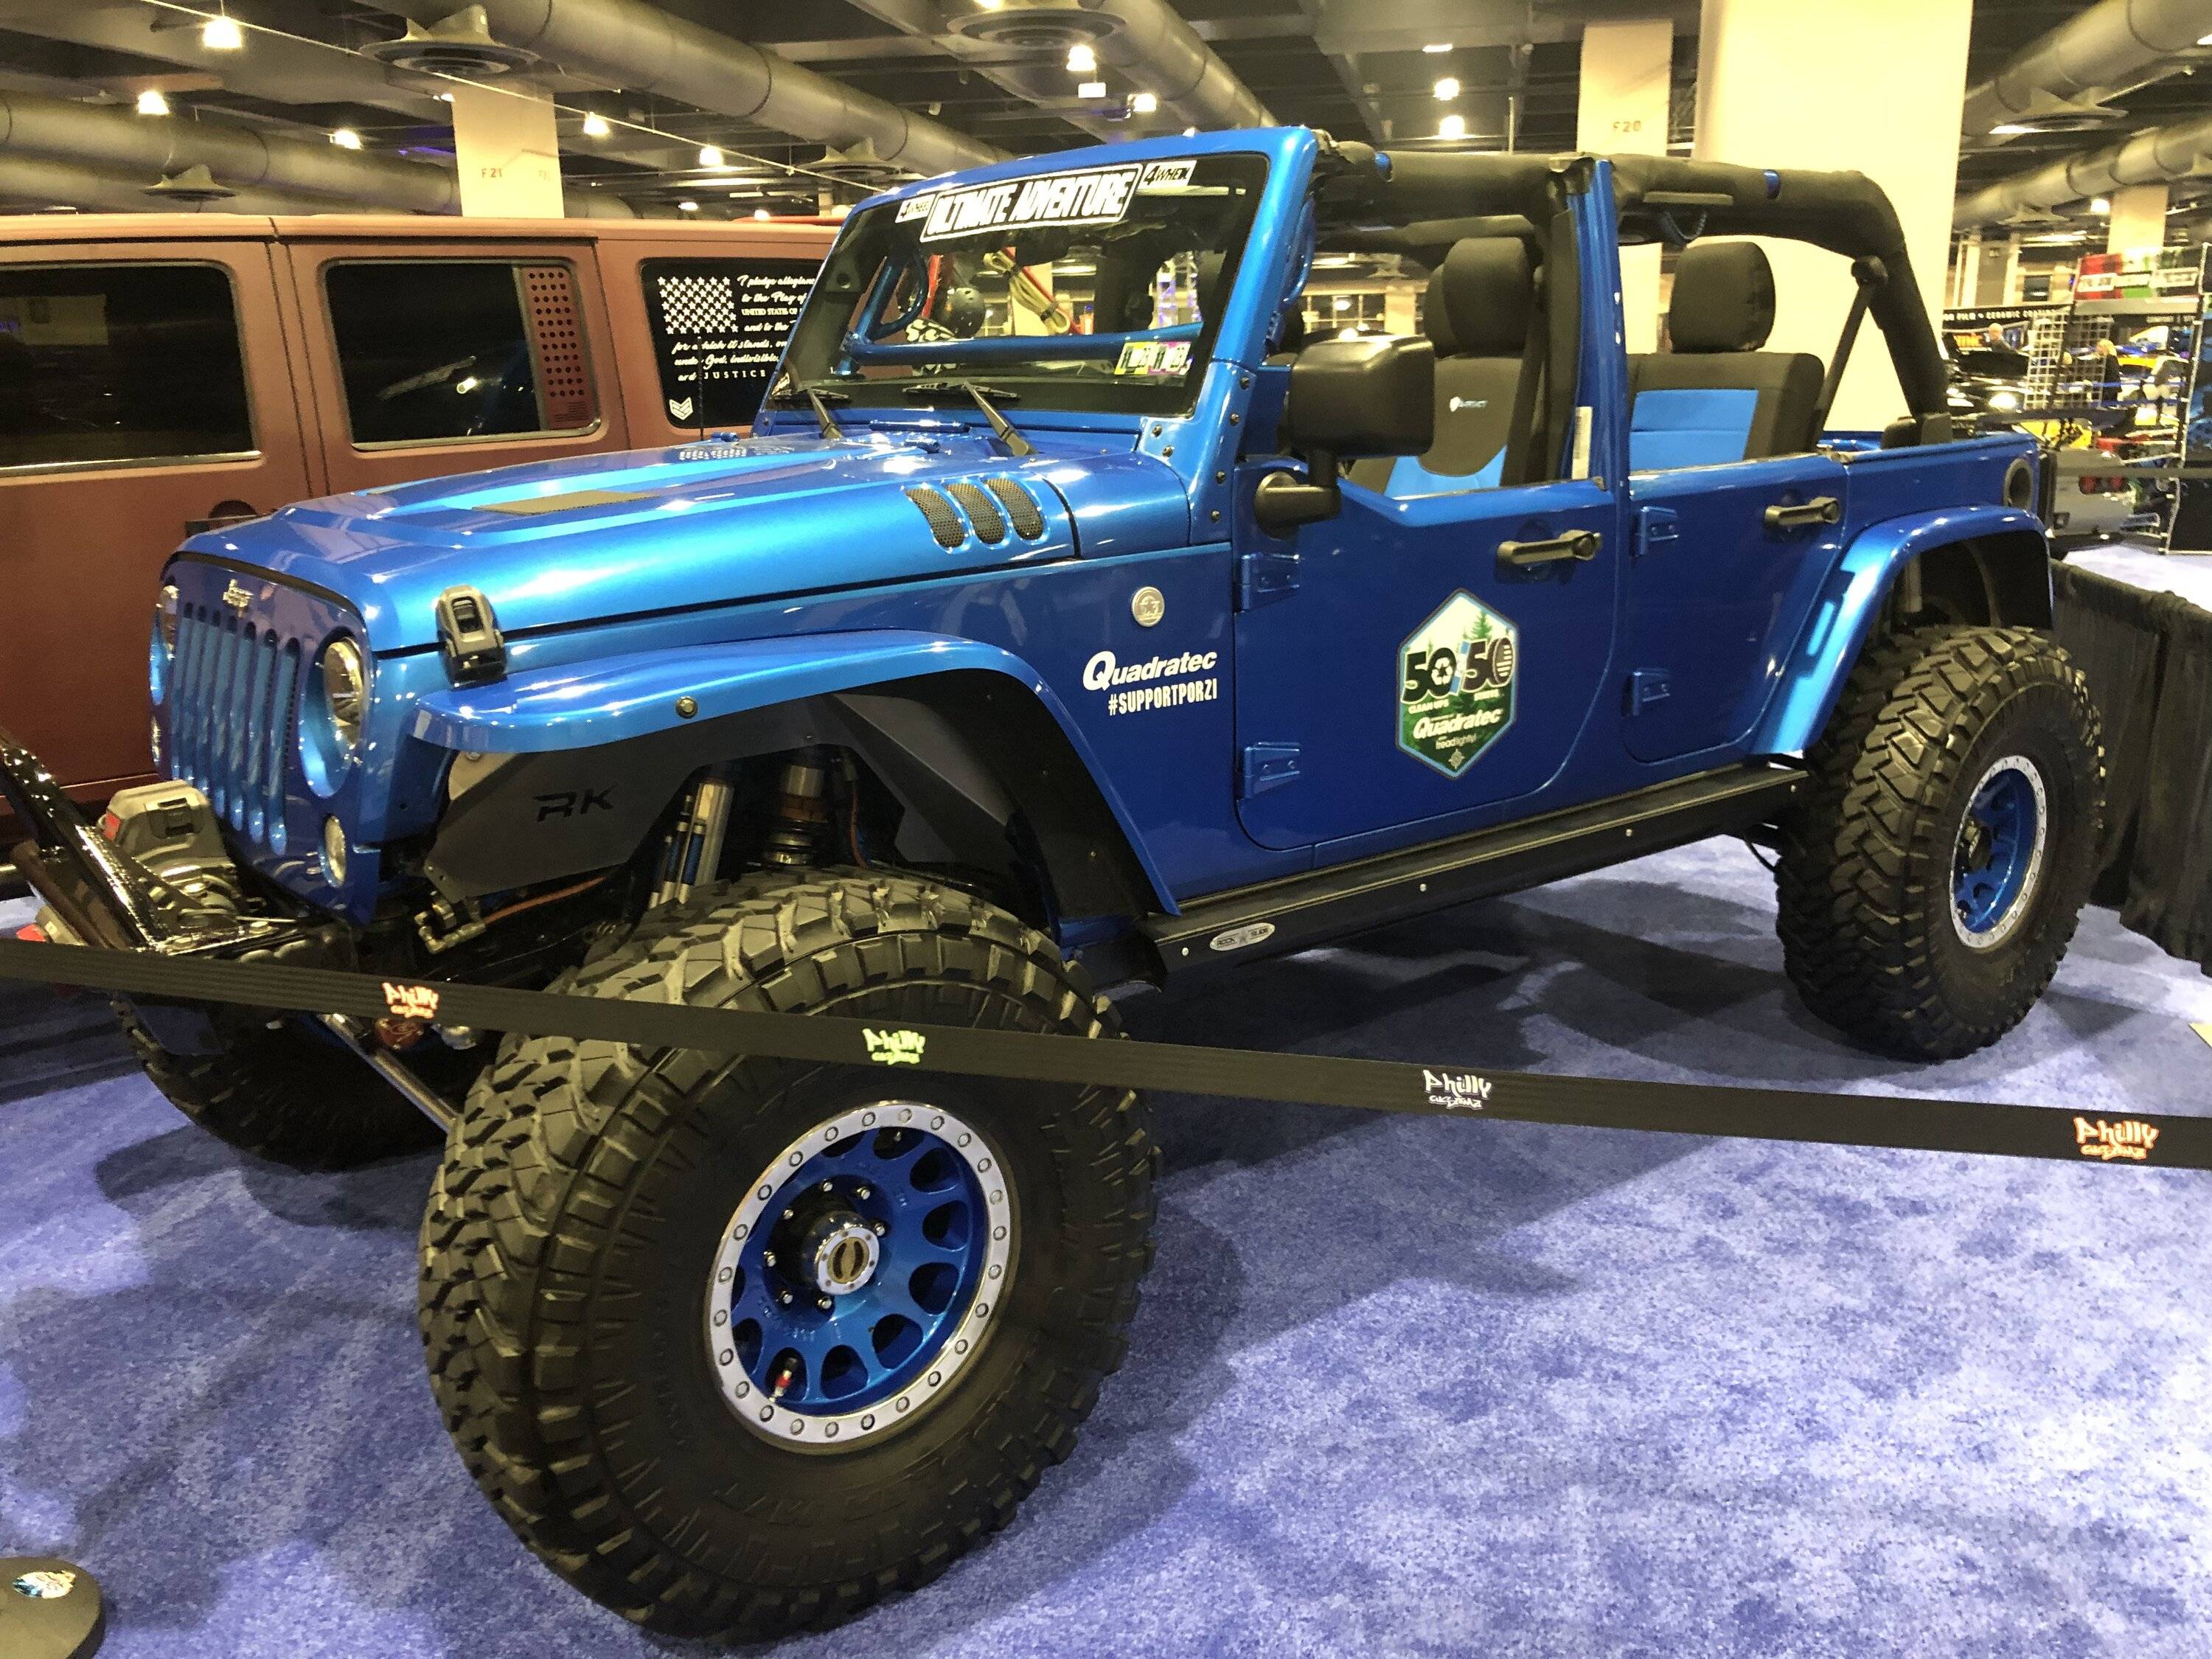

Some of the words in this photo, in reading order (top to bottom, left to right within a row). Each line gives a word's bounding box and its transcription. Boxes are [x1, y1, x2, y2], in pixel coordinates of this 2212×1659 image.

[927, 183, 1013, 235] ULTIMATE
[1008, 170, 1136, 222] ADVENTURE
[746, 276, 777, 289] pledge
[703, 369, 767, 380] JUSTICE
[1082, 650, 1218, 692] Quadratec
[1413, 708, 1503, 740] Quadratec
[1422, 1069, 1492, 1099] Philly
[2073, 1116, 2159, 1150] Philly
